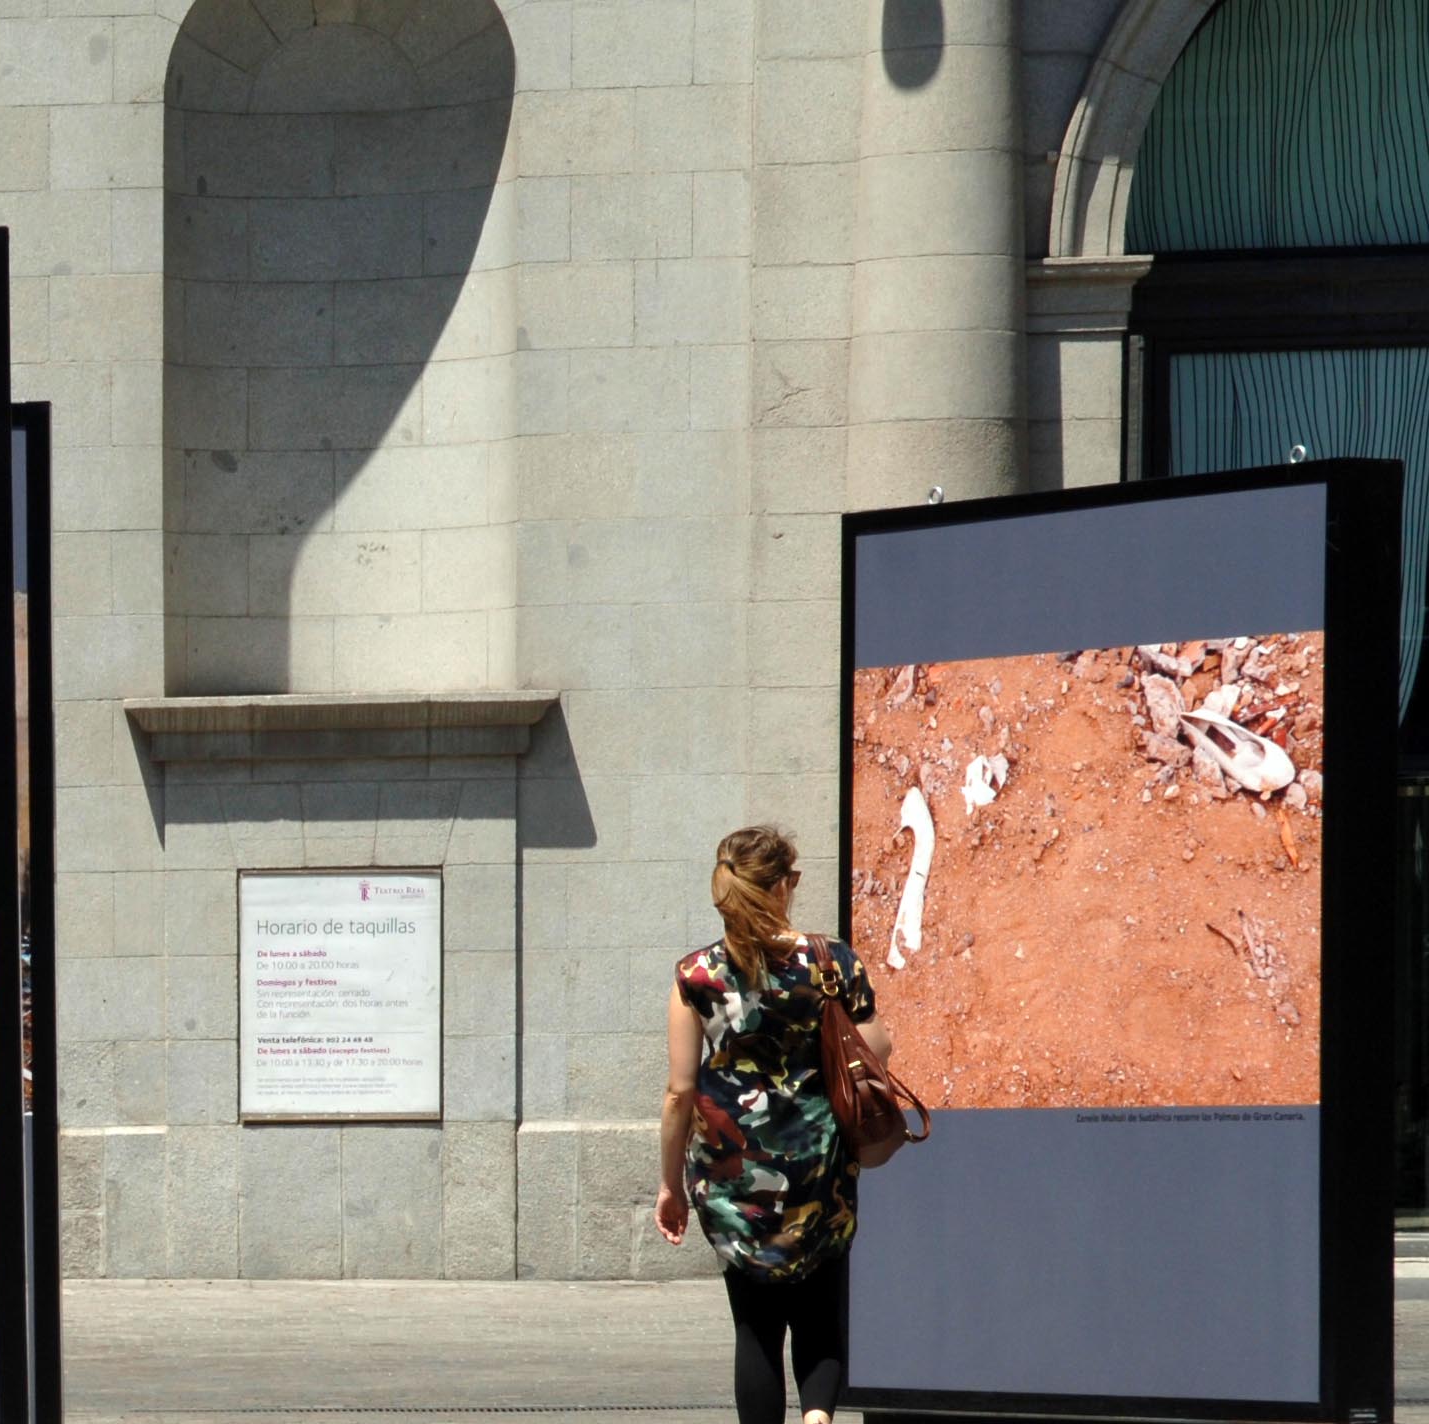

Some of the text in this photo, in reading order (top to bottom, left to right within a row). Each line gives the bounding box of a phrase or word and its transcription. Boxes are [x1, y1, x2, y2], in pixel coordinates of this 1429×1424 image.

[257, 917, 416, 938] Horario de taquillas
[257, 950, 268, 958] De
[270, 950, 290, 958] lunes
[299, 949, 327, 958] sábado
[256, 961, 269, 970] De
[336, 960, 360, 969] horas
[257, 979, 296, 988] Domingos
[305, 978, 337, 986] festivos
[257, 1000, 273, 1008] Con
[342, 999, 359, 1008] dos
[360, 998, 383, 1007] horas
[385, 999, 408, 1007] antes
[257, 1010, 268, 1019] de
[257, 1036, 280, 1044] Venta
[282, 1035, 324, 1044] telefónica:
[257, 1047, 268, 1055] De
[270, 1047, 290, 1055] lunes
[299, 1046, 327, 1054] sábado
[1253, 1111, 1272, 1121] Gran
